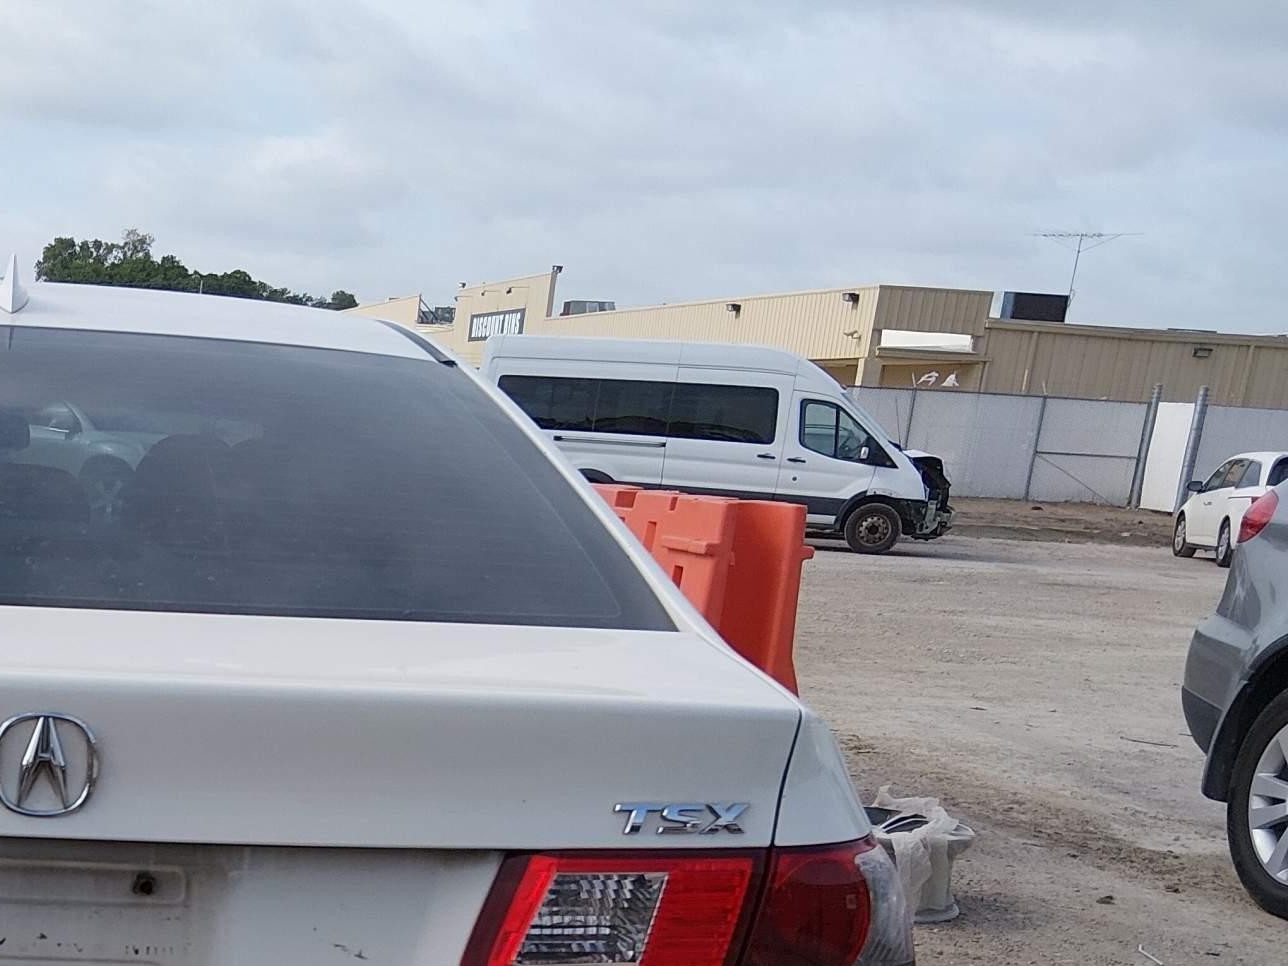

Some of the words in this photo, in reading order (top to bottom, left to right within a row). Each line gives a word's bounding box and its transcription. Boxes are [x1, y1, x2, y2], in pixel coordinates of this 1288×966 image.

[471, 314, 504, 337] DISCOUNT
[503, 312, 521, 335] BINS
[613, 803, 750, 835] TSX
